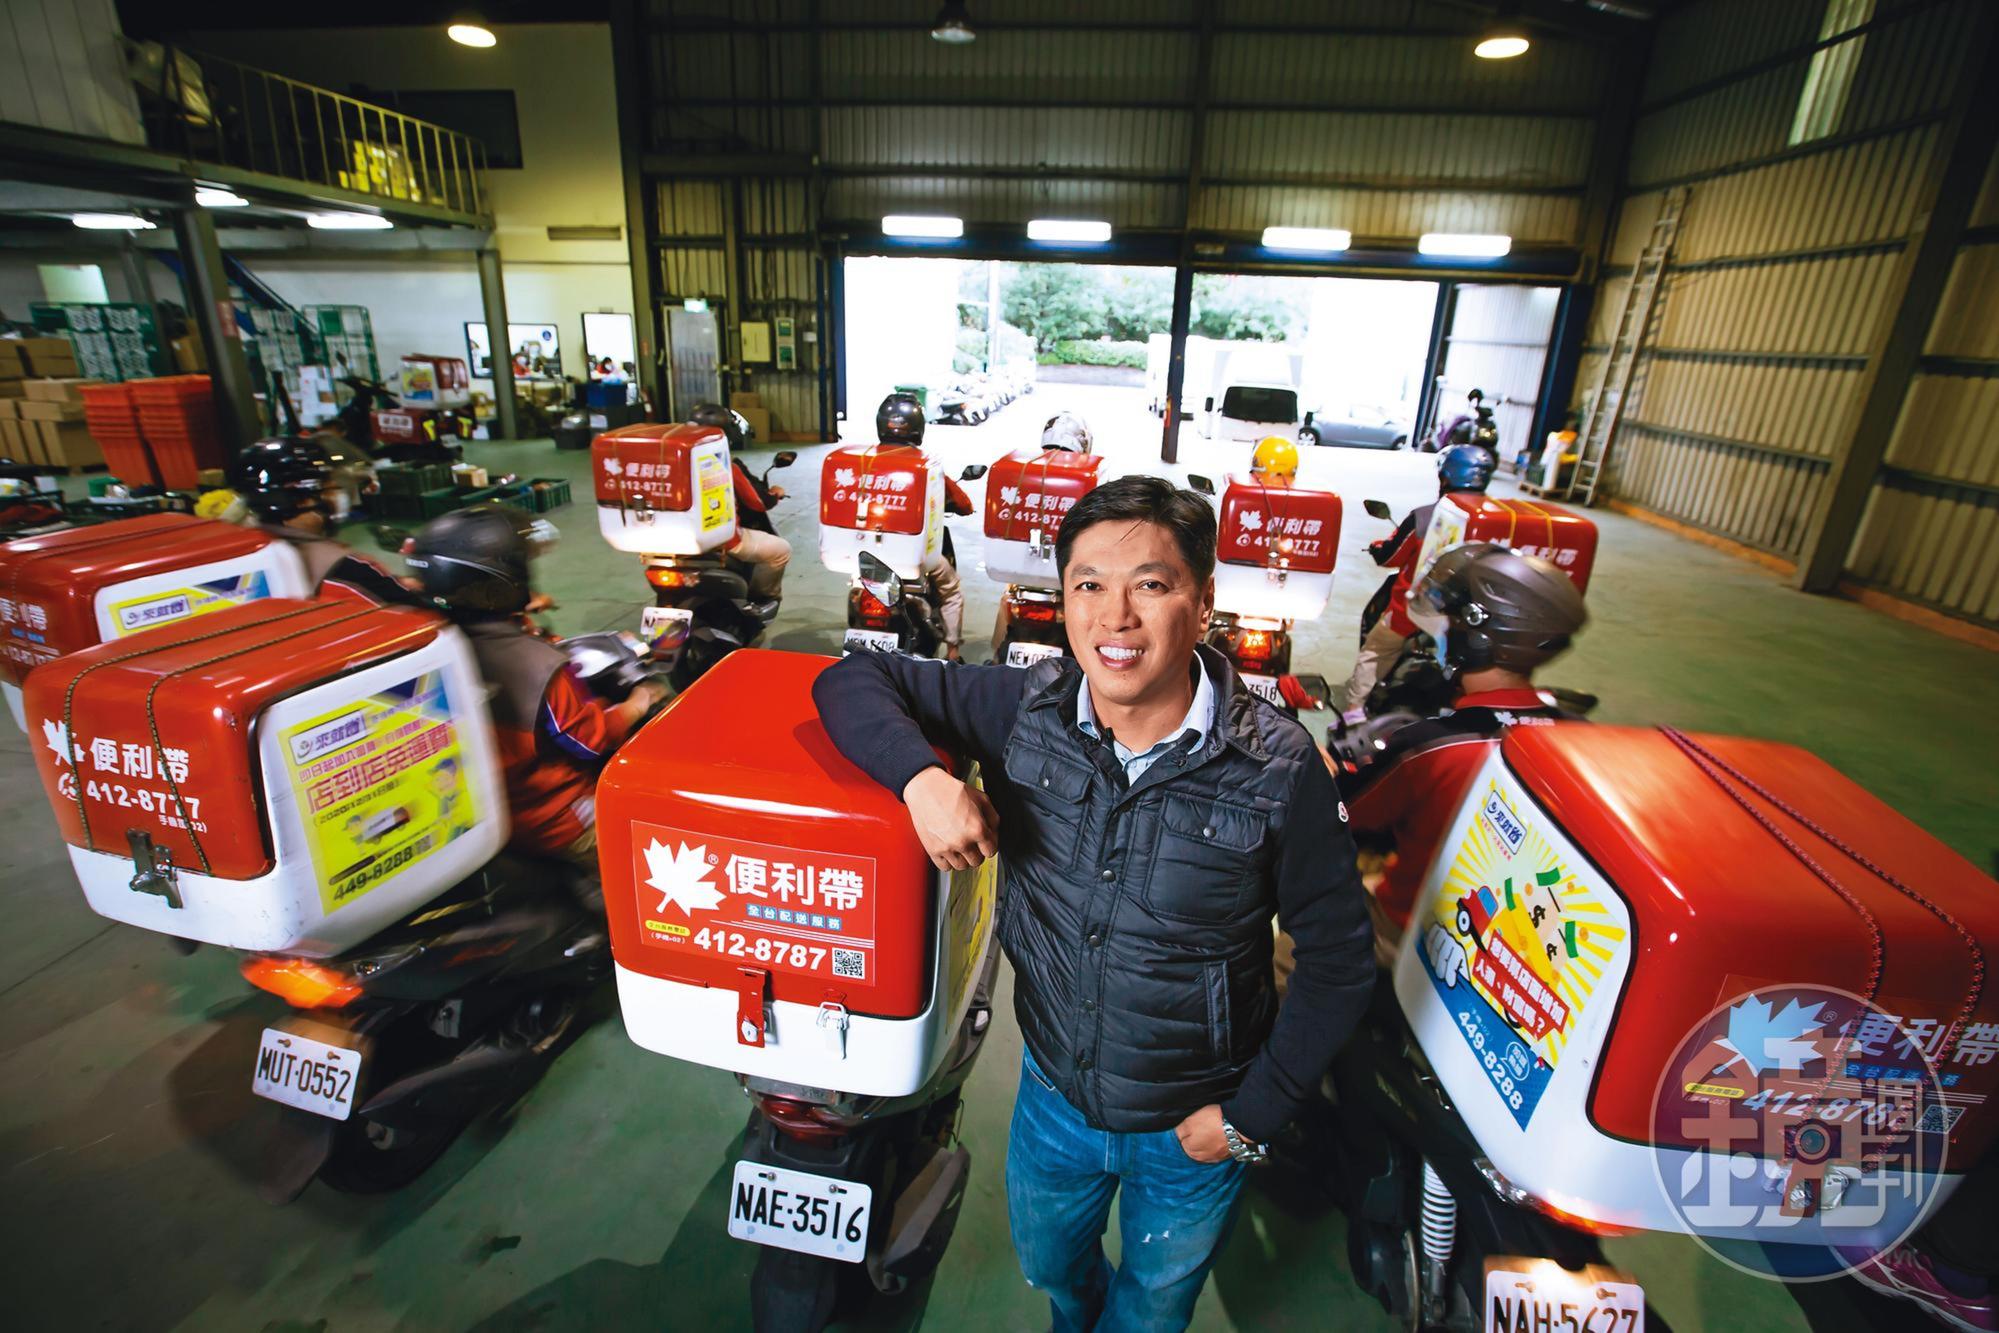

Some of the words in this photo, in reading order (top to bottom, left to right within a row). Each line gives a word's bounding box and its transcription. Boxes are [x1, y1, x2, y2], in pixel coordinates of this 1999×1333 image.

[90, 737, 189, 783] 便利帶
[724, 854, 864, 911] 便利帶
[747, 903, 842, 931] 全台配送服務
[693, 927, 827, 971] 412-8787
[258, 1046, 352, 1103] MUT-0552
[1459, 1012, 1523, 1110] 449-8288
[734, 1182, 865, 1243] NAE-3516
